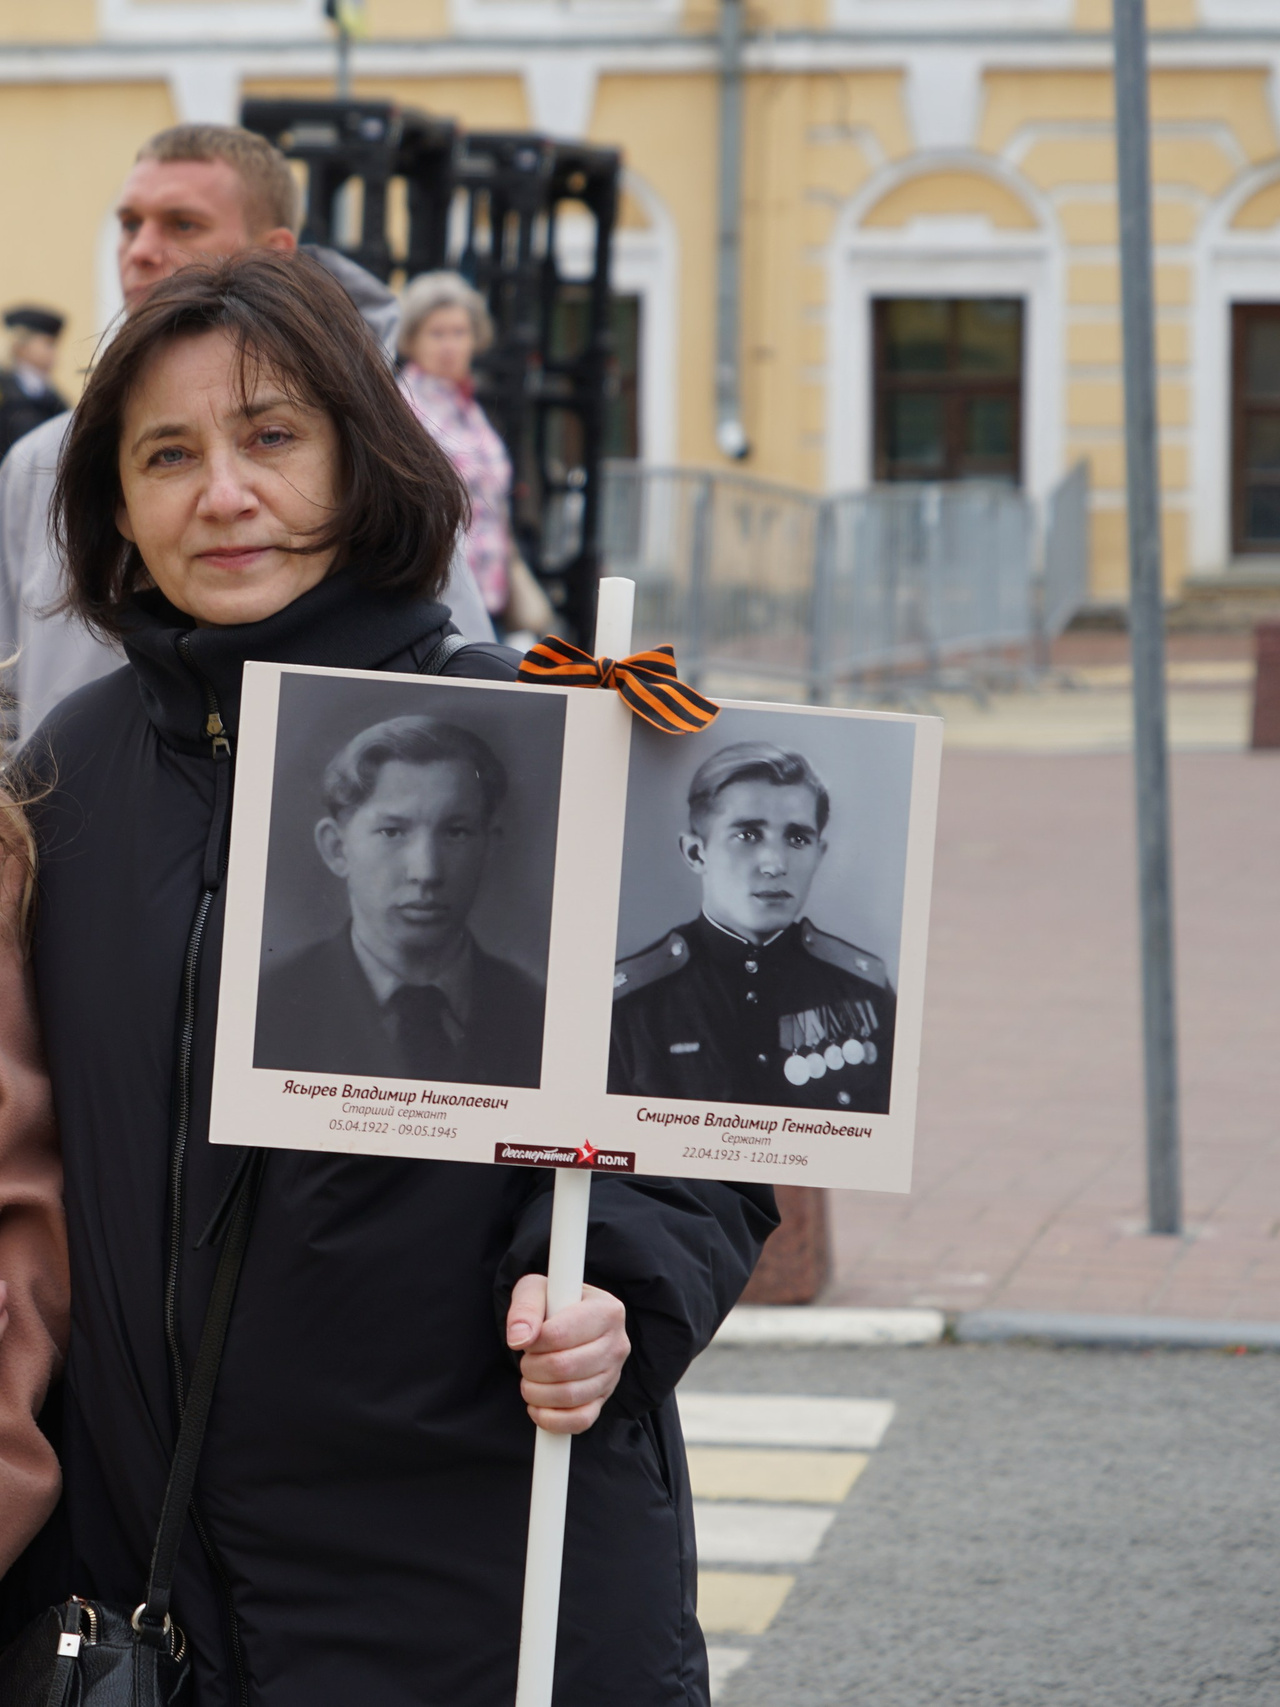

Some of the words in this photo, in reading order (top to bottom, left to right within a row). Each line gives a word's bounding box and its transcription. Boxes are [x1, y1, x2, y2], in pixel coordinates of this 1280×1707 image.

[282, 1080, 337, 1098] Ясырев
[341, 1083, 417, 1103] Владимир
[420, 1090, 509, 1109] Николаевич
[342, 1102, 394, 1116] Старший
[397, 1107, 447, 1121] сержант
[329, 1119, 389, 1133] 05.04.1922
[398, 1123, 457, 1138] 09.05.1945
[636, 1108, 700, 1126] Смирнов
[704, 1112, 778, 1133] Владимир
[782, 1118, 872, 1138] Геннадьевич
[721, 1132, 770, 1146] Сержант
[682, 1147, 740, 1161] 22.04.1923
[751, 1152, 808, 1166] 12.01.1996
